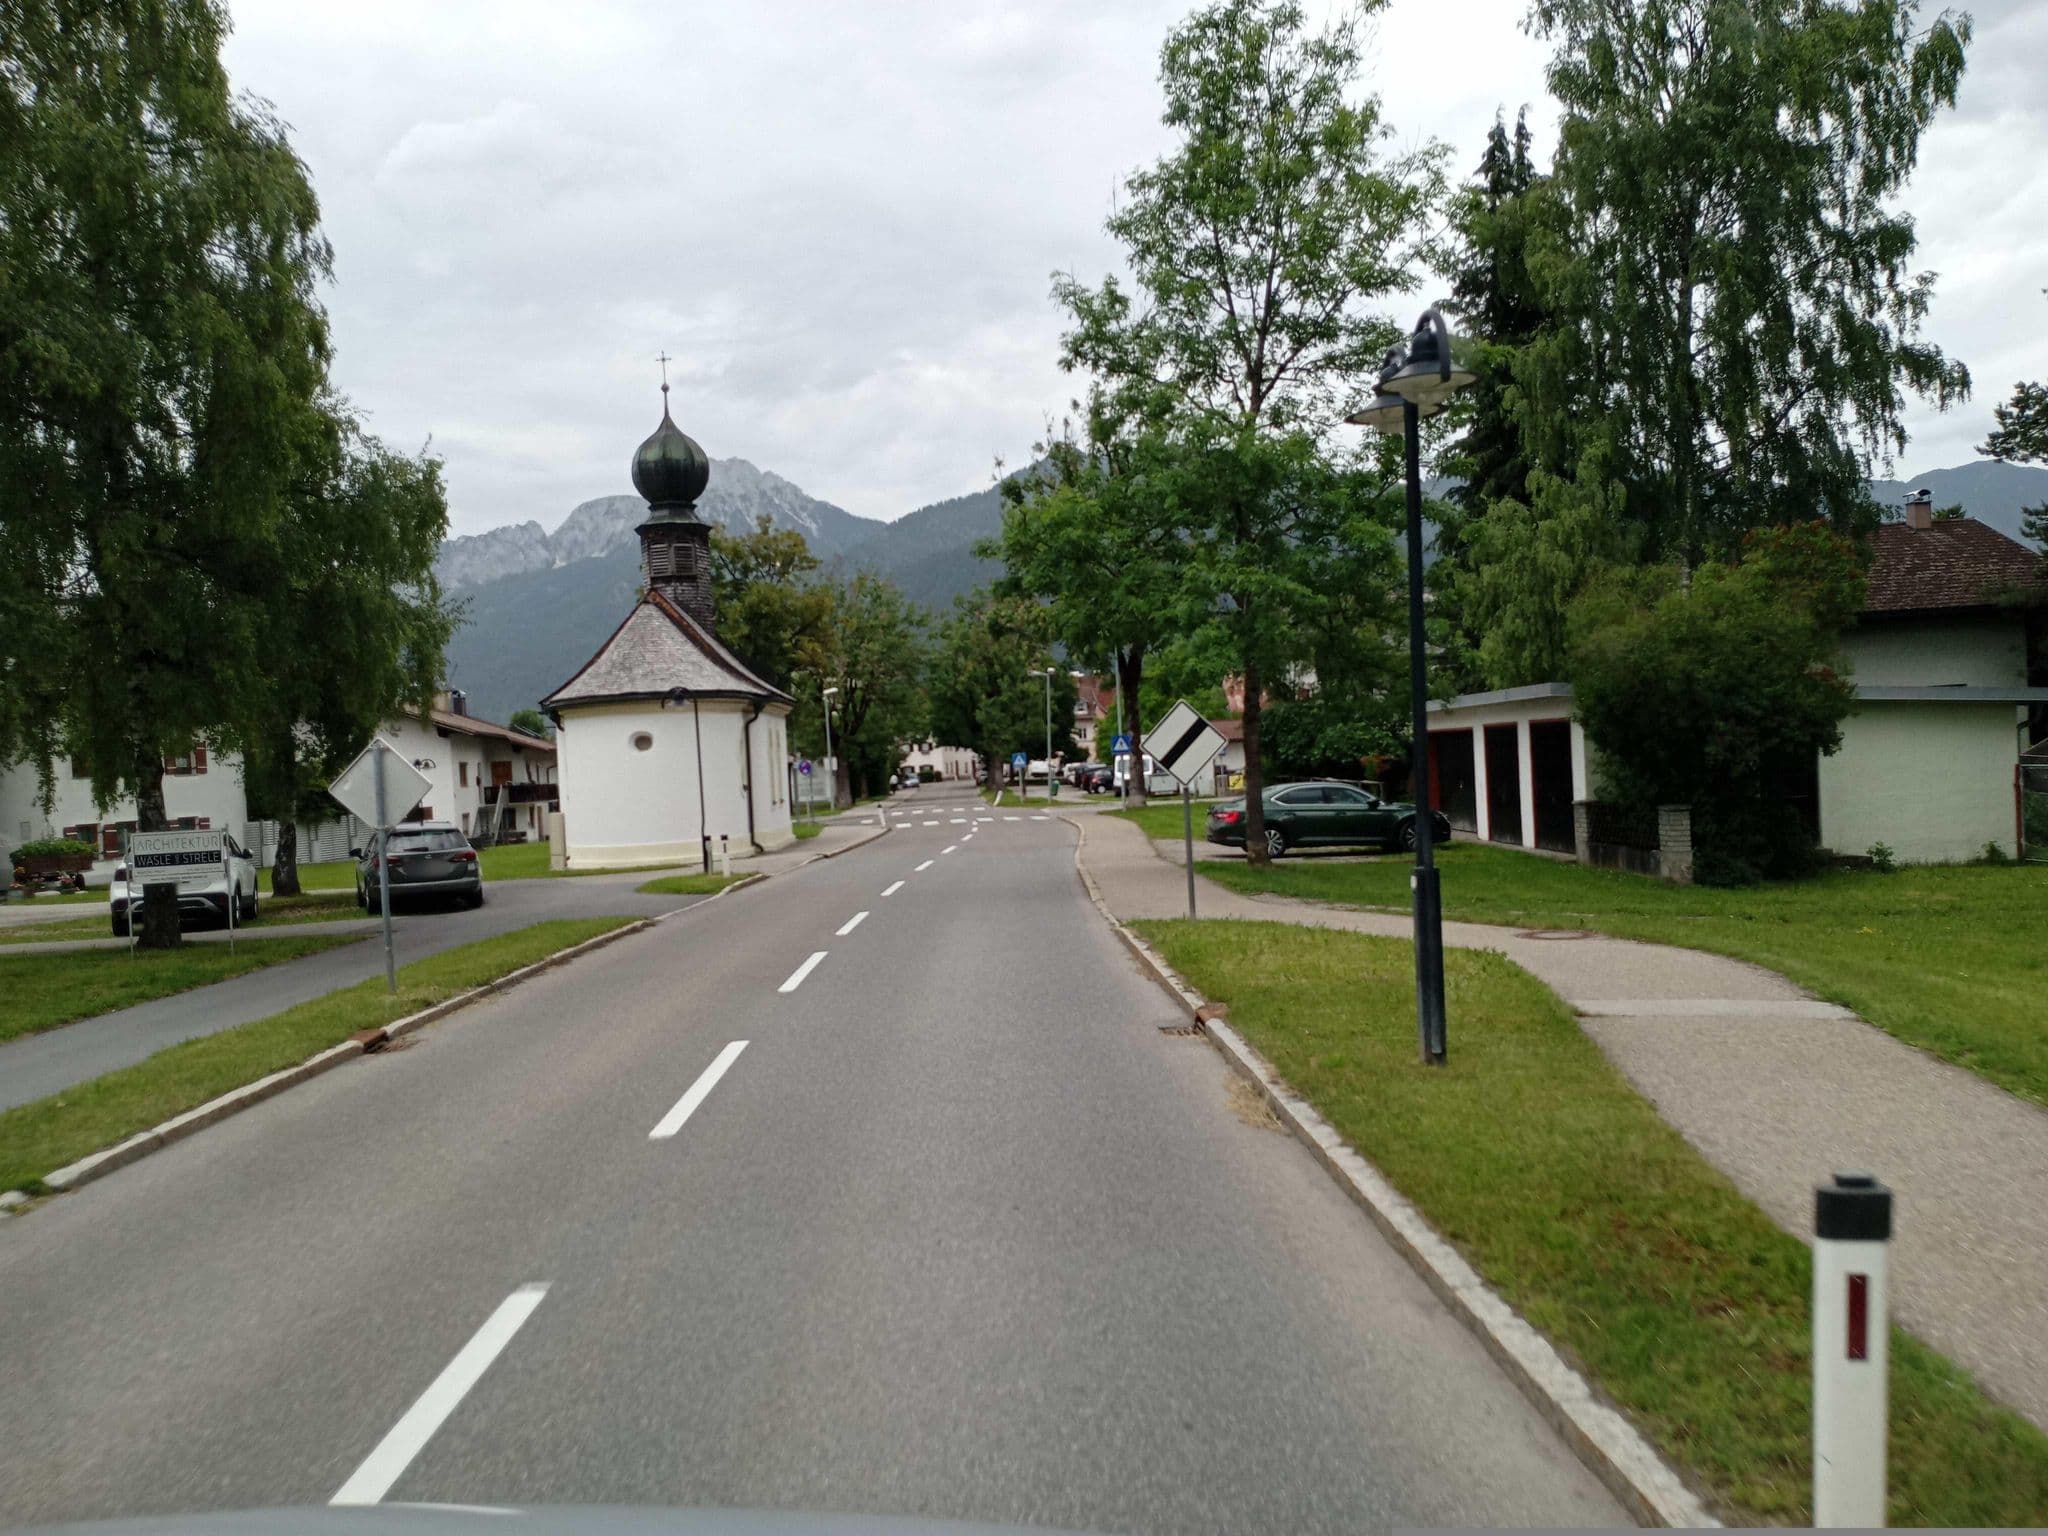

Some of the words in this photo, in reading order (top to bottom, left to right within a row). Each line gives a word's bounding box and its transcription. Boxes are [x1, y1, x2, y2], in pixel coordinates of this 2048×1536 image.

[137, 836, 218, 851] ARCHITEKTUR
[137, 854, 171, 866] WASLE
[183, 852, 219, 864] STRELE
